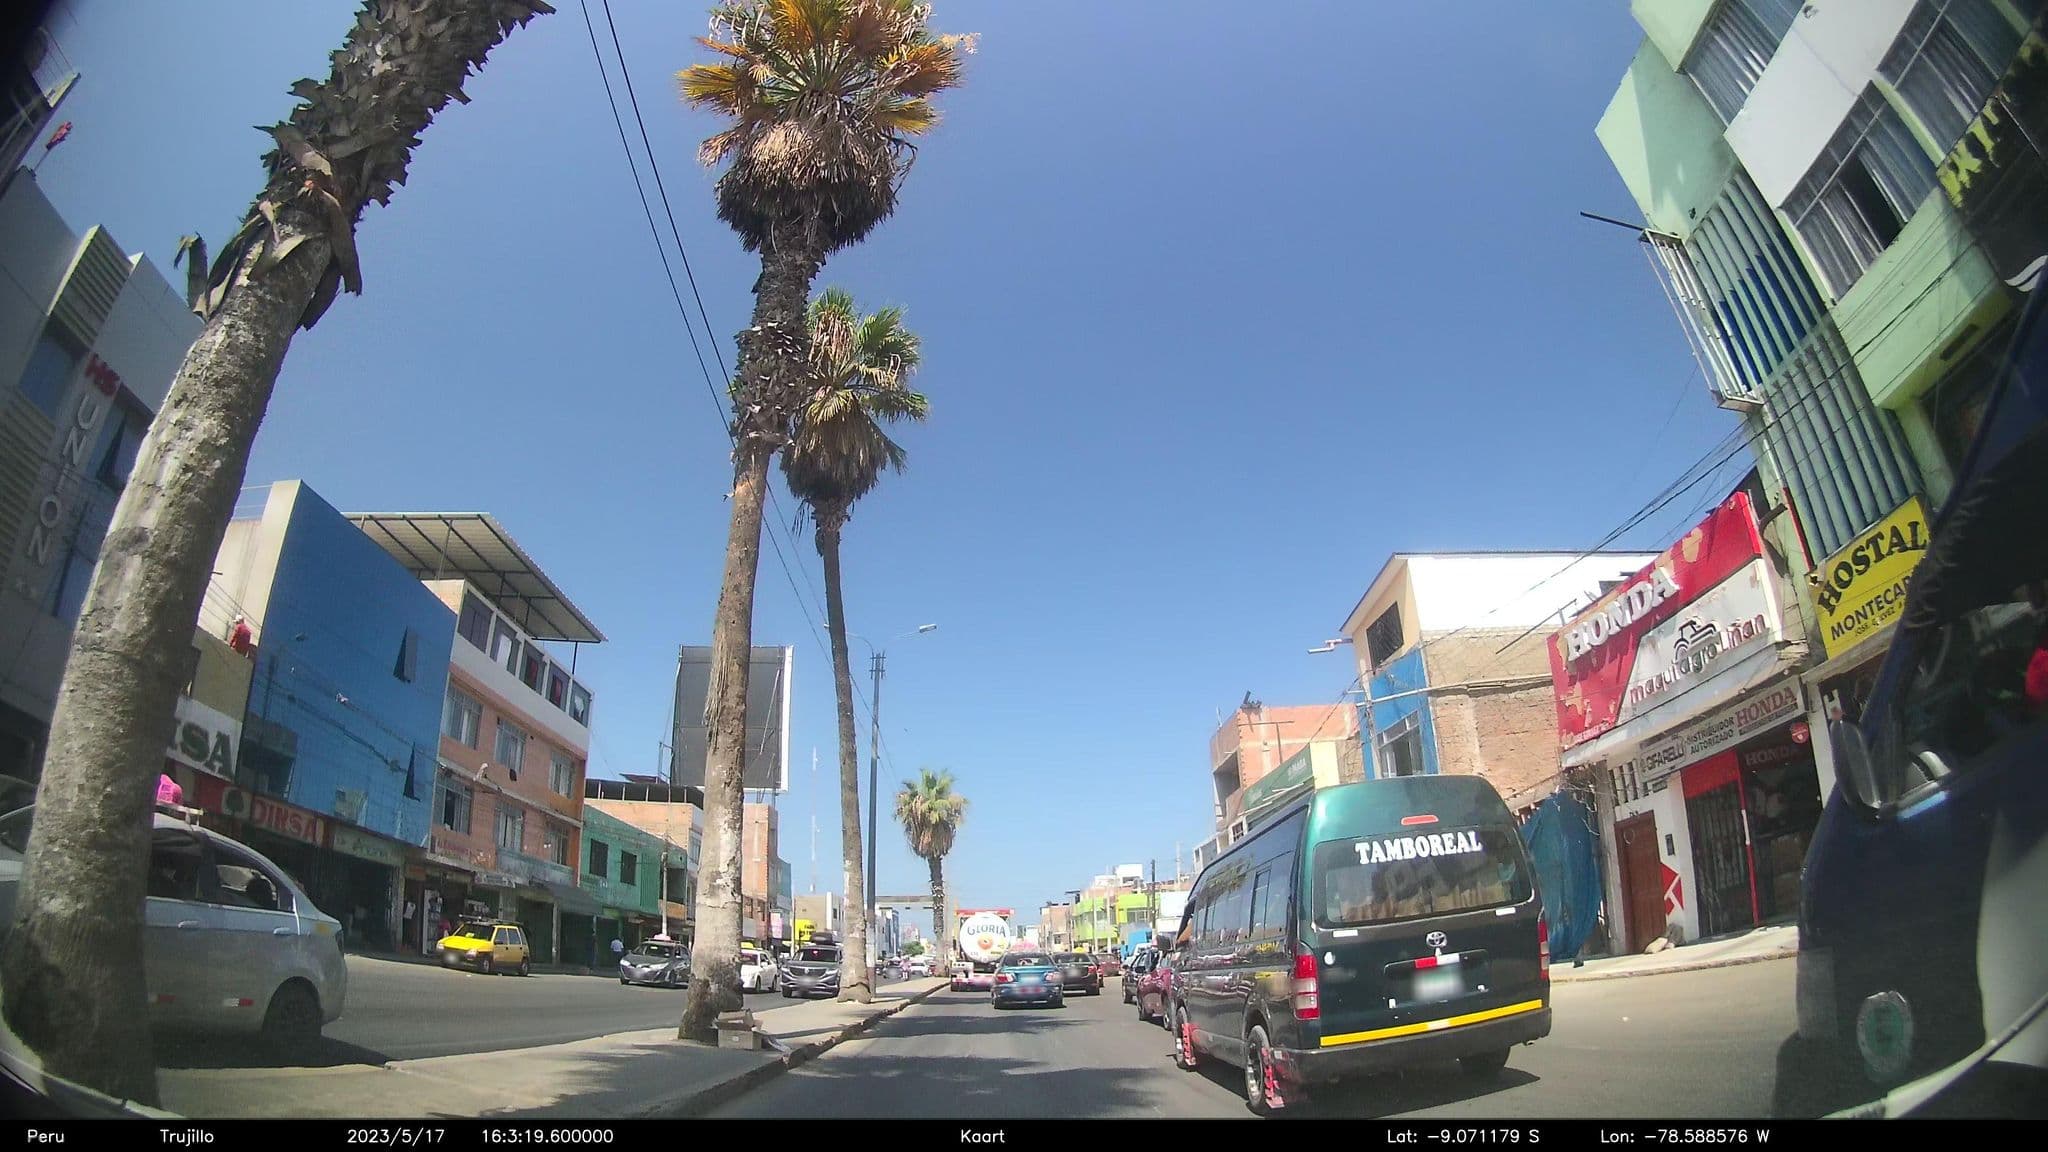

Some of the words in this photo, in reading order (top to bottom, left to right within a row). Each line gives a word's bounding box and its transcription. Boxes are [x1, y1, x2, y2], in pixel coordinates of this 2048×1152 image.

[28, 394, 99, 567] UNION
[1817, 520, 1928, 618] HOSTAL
[1564, 566, 1681, 662] HONDA
[1735, 686, 1797, 729] HONDA
[1690, 728, 1735, 755] AUTORIZADO
[1354, 829, 1483, 865] TAMBOREAL
[966, 924, 1006, 938] GLORIA
